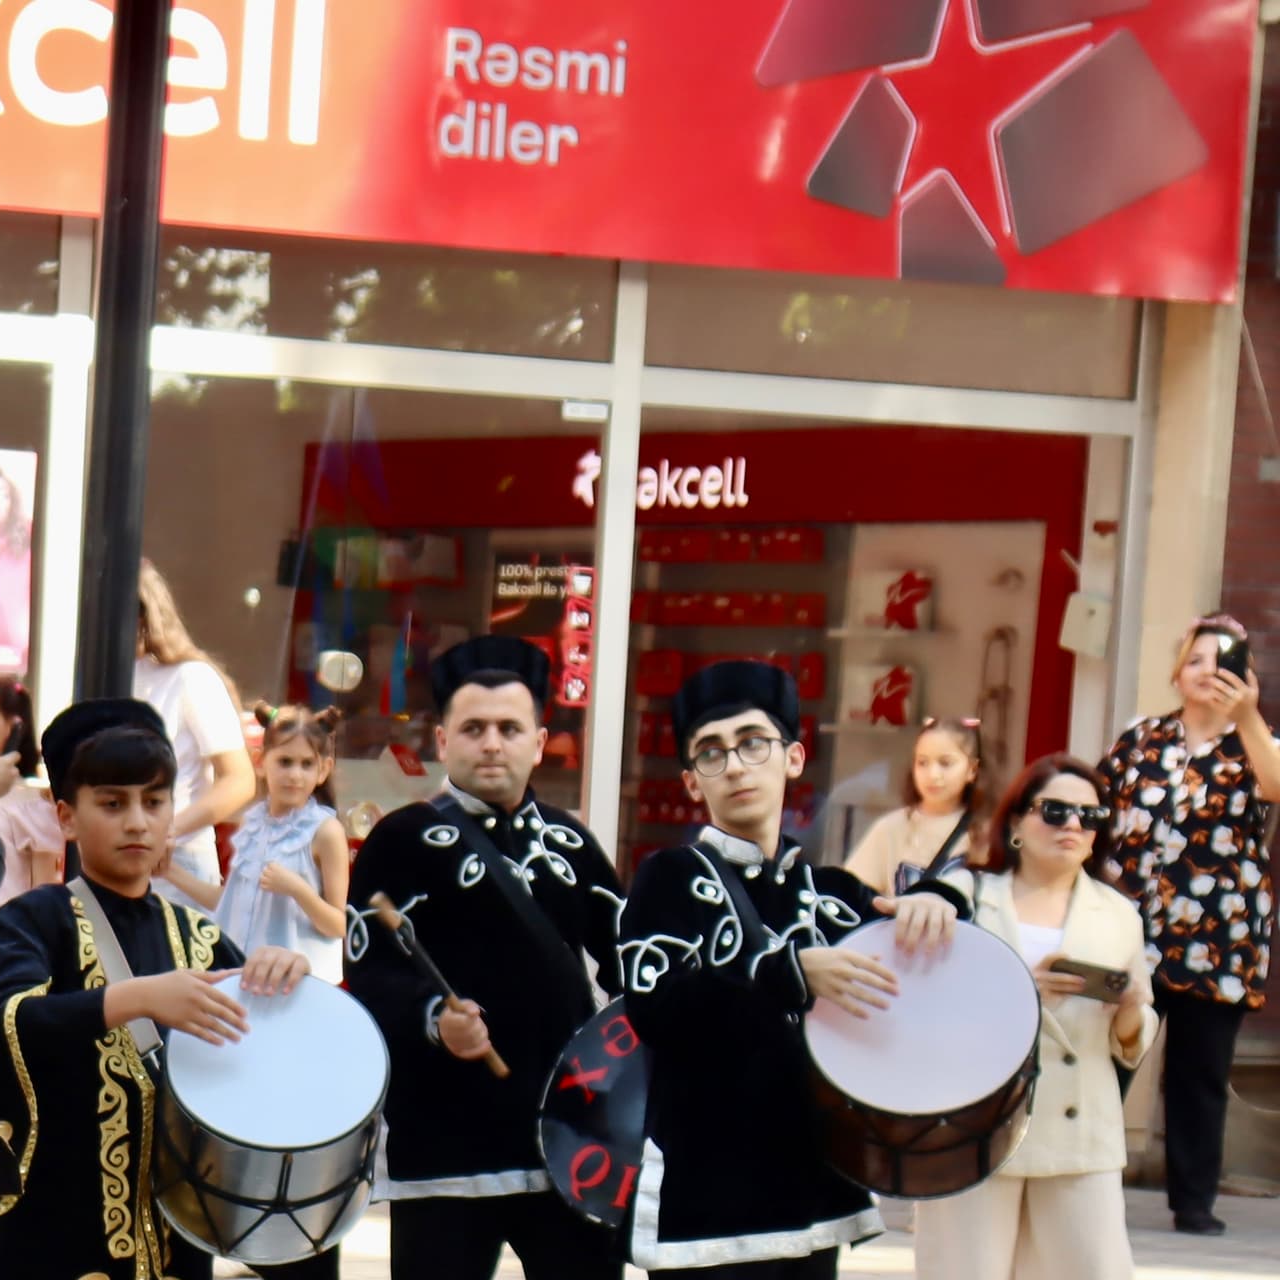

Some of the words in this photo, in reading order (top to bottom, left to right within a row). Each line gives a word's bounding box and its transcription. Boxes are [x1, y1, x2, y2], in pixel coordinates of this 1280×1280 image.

[444, 26, 628, 96] Rəsmi
[438, 99, 580, 167] diler
[636, 456, 750, 510] akcell
